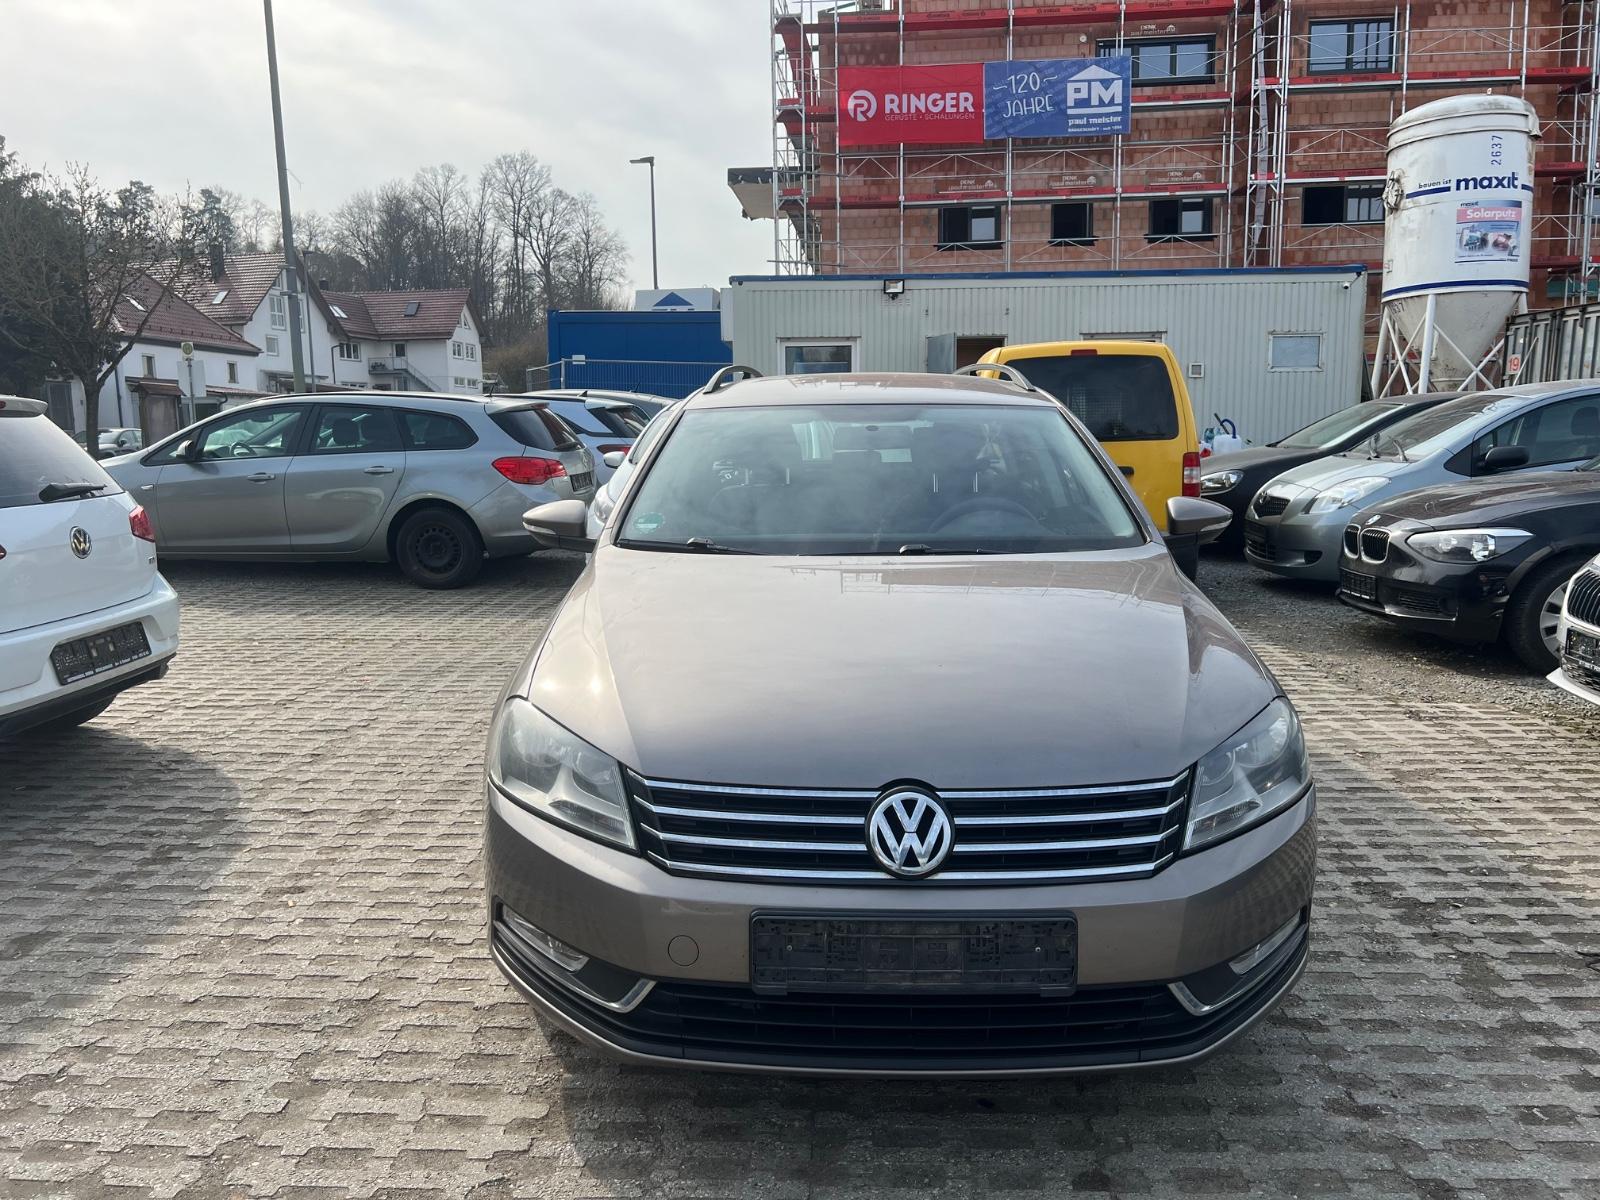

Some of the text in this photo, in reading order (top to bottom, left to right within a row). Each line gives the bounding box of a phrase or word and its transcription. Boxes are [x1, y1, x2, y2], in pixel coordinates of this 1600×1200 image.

[1007, 72, 1040, 94] 120
[1066, 79, 1123, 107] PM
[884, 91, 975, 114] RINGER
[1002, 94, 1055, 118] JAHRE
[884, 112, 975, 121] GERÜSTE SCHALUNGEN
[1068, 115, 1122, 126] paul meister
[1490, 135, 1504, 167] 2637
[1418, 181, 1441, 189] bauen
[1455, 172, 1519, 191] maxit
[1466, 209, 1517, 220] Solarputz
[1509, 357, 1520, 371] 19
